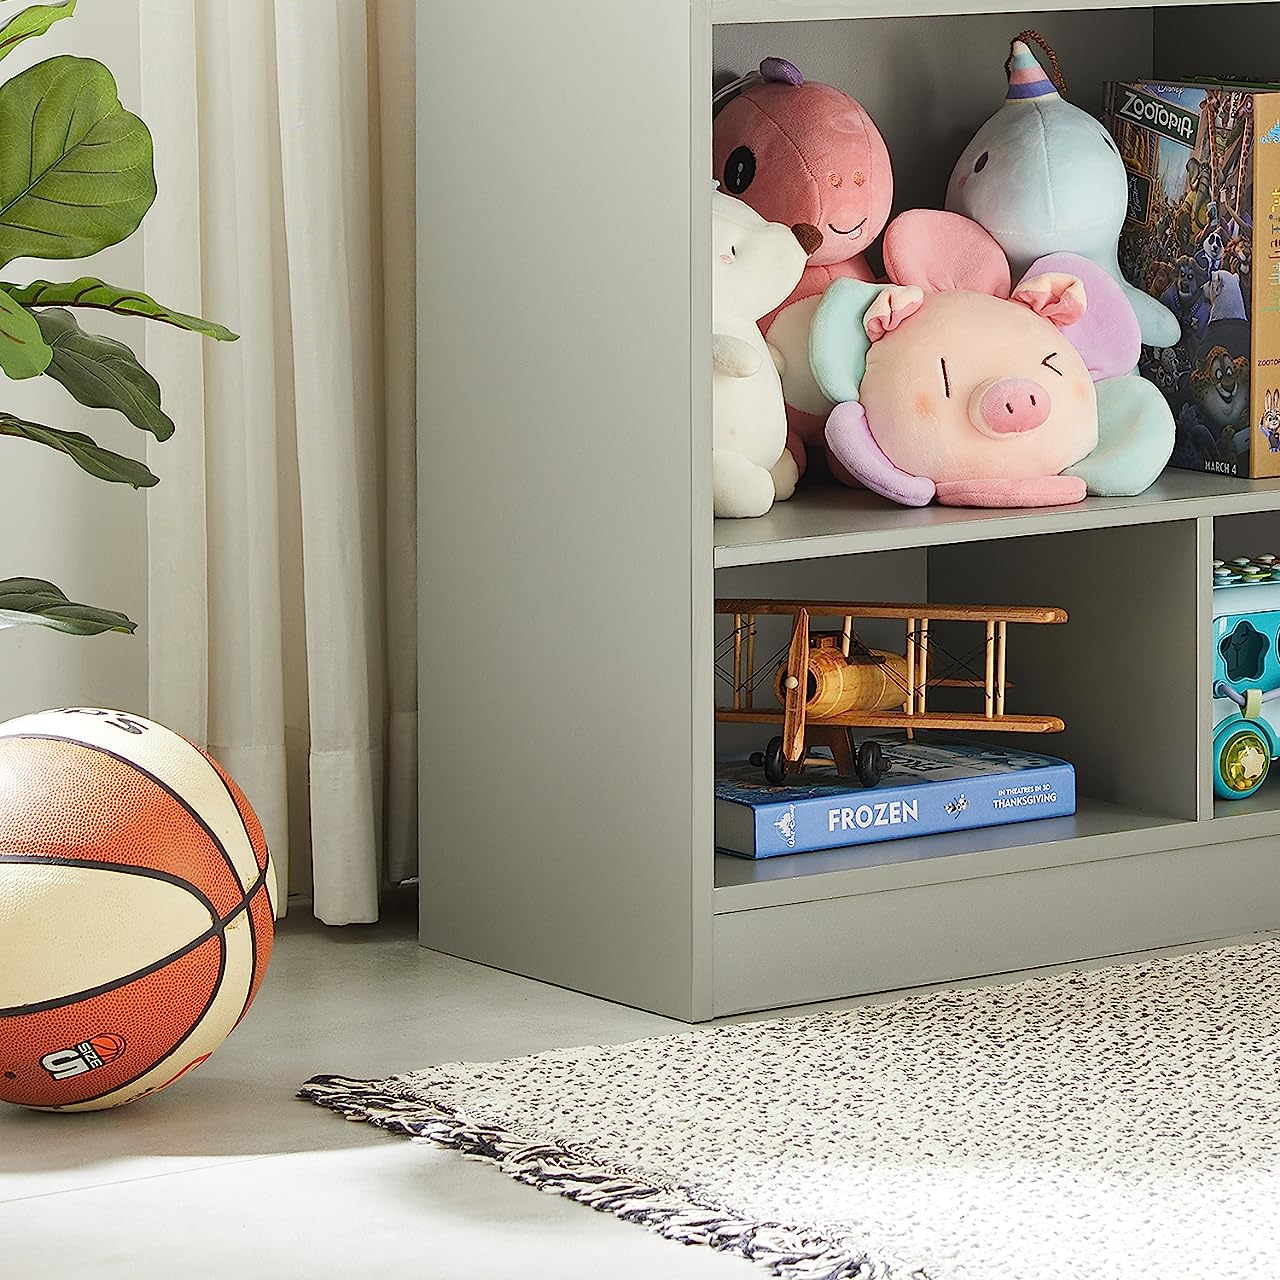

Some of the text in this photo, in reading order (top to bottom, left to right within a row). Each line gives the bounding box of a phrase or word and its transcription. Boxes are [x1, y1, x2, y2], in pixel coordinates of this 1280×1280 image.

[1119, 90, 1195, 139] ZOOTOPIA
[1204, 460, 1238, 475] MARCH 4
[993, 792, 1057, 809] THANKSGIVING
[998, 788, 1006, 796] IN
[828, 799, 919, 832] FROZEN
[77, 1042, 103, 1069] SIZE
